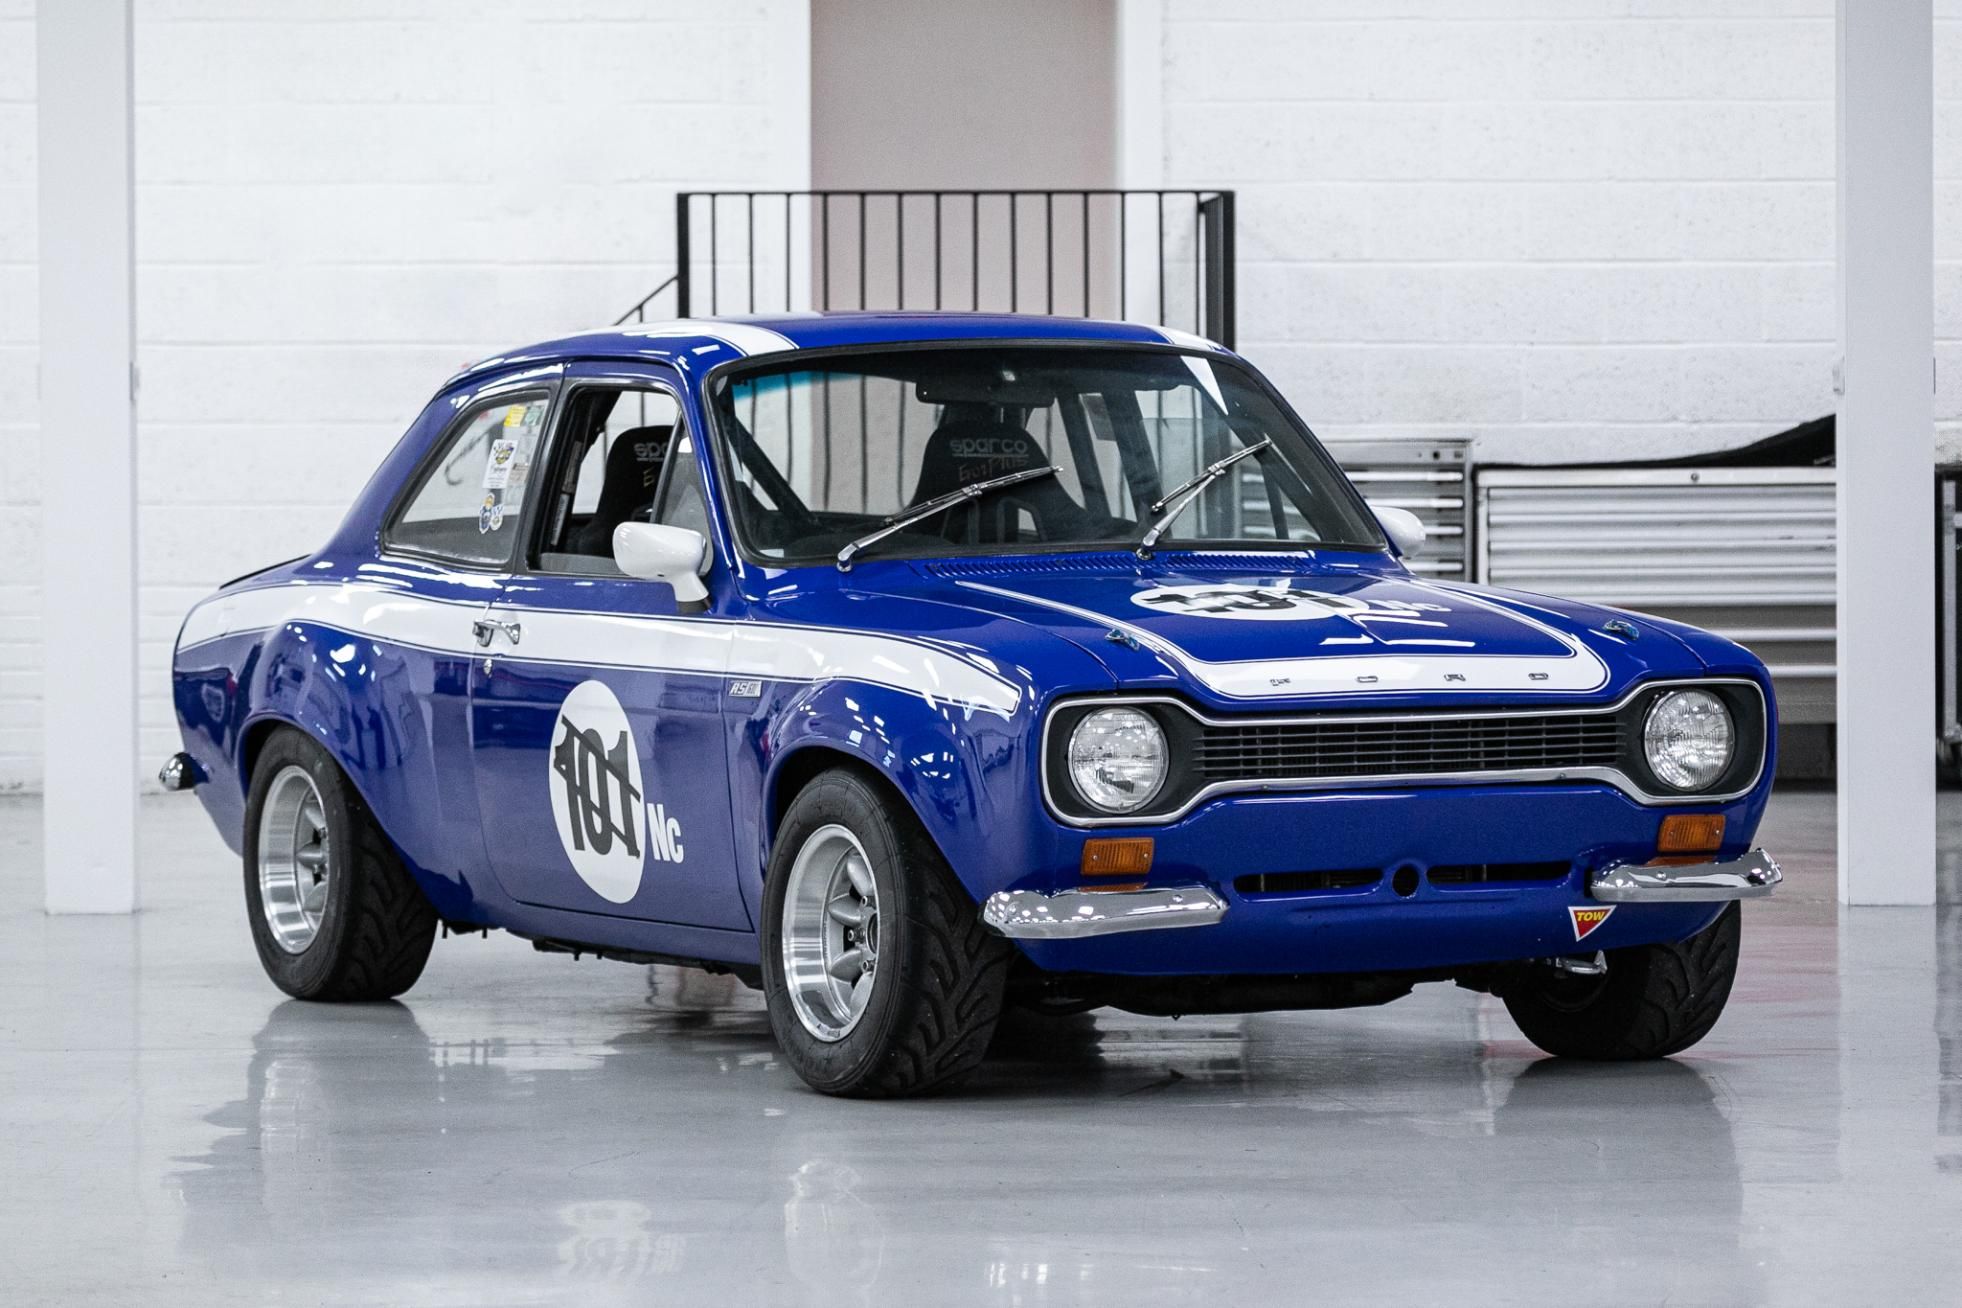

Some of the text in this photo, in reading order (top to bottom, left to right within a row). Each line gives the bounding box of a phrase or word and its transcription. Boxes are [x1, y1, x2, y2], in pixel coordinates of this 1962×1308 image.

[950, 438, 1028, 457] sparco
[1270, 672, 1549, 687] FORD
[1576, 911, 1605, 922] TOW
